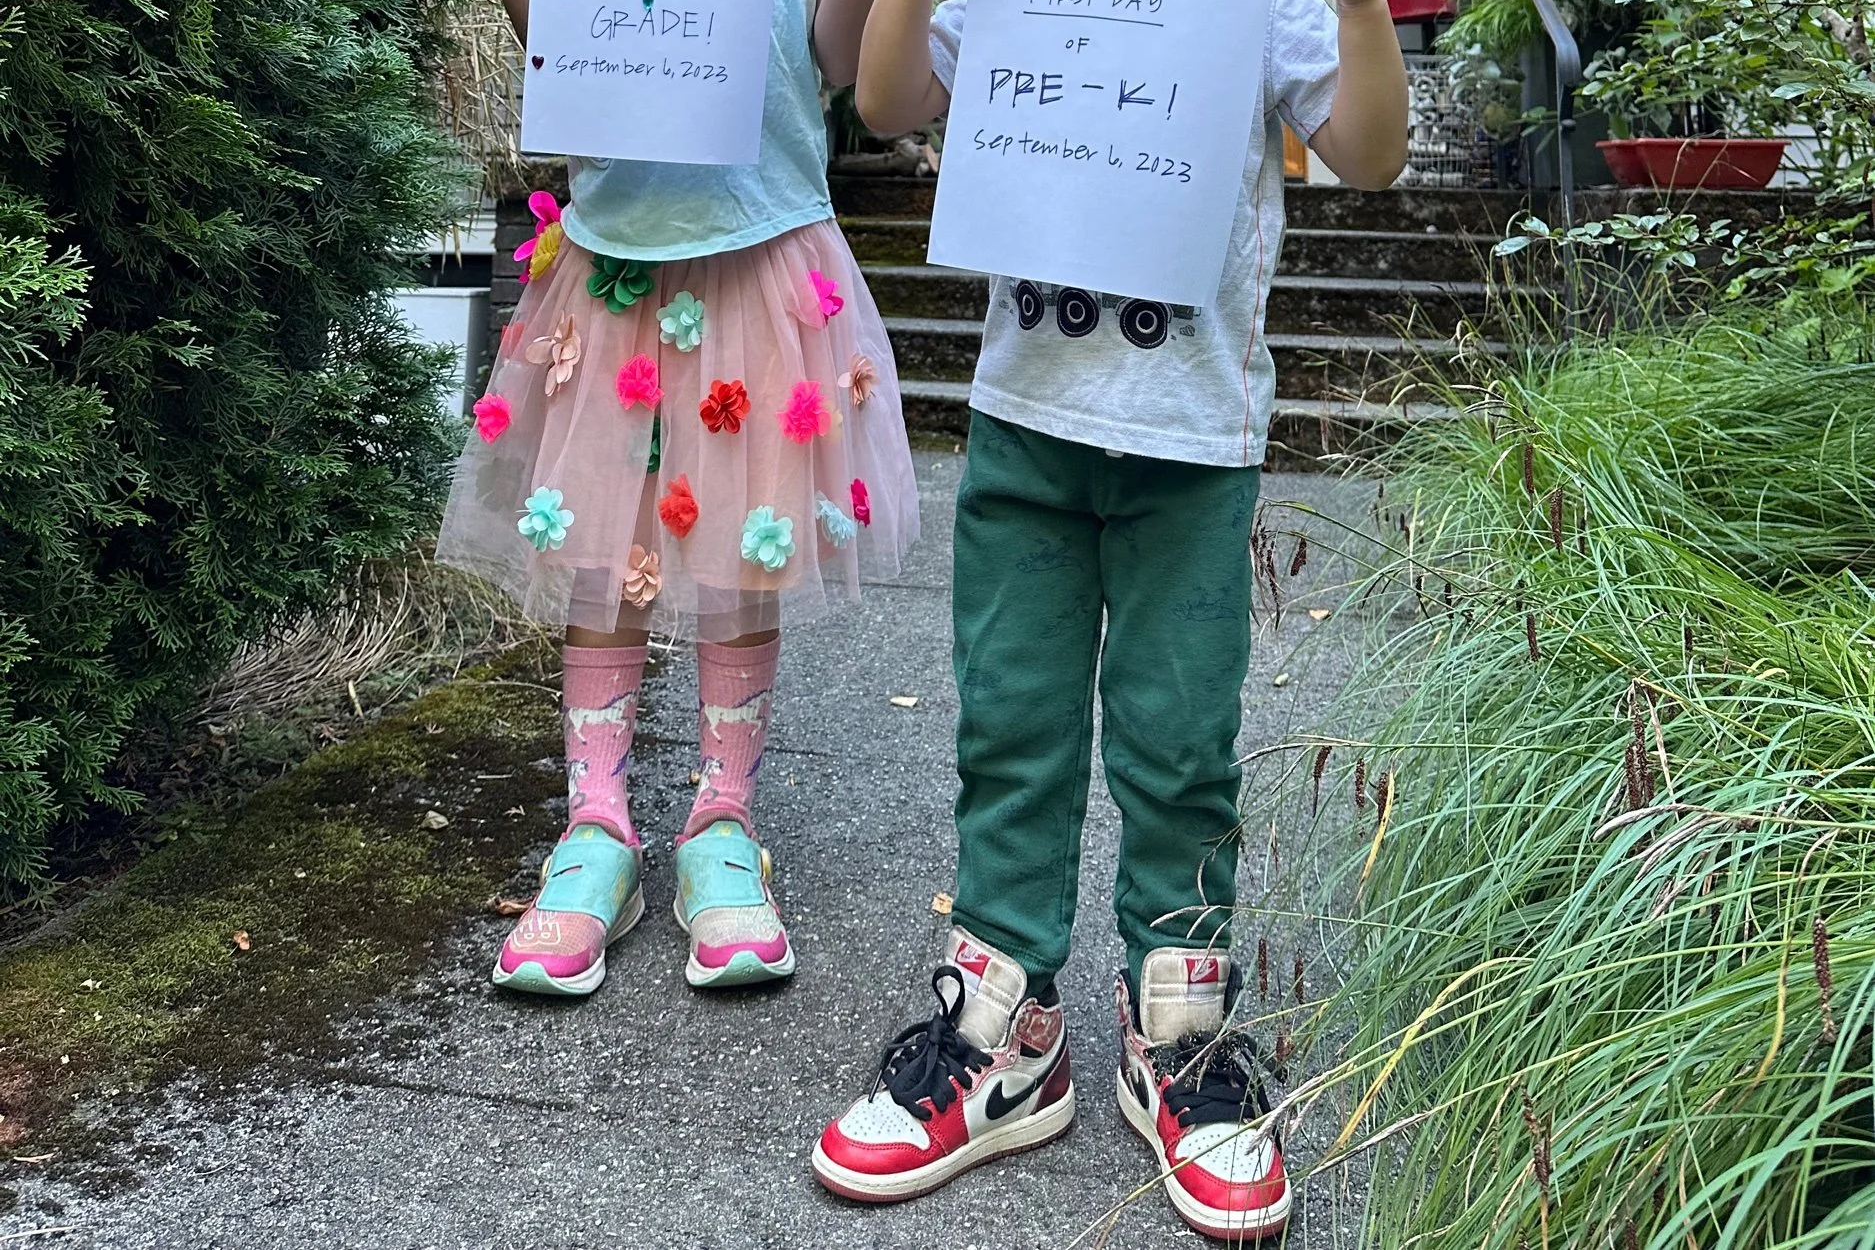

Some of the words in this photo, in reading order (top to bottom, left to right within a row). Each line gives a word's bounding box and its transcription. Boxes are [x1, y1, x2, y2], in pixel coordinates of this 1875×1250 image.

[590, 5, 715, 45] GRADE!
[1065, 37, 1091, 54] OF
[555, 54, 656, 77] September
[680, 61, 729, 84] 2023
[973, 129, 1099, 162] September
[1135, 152, 1192, 183] 2023
